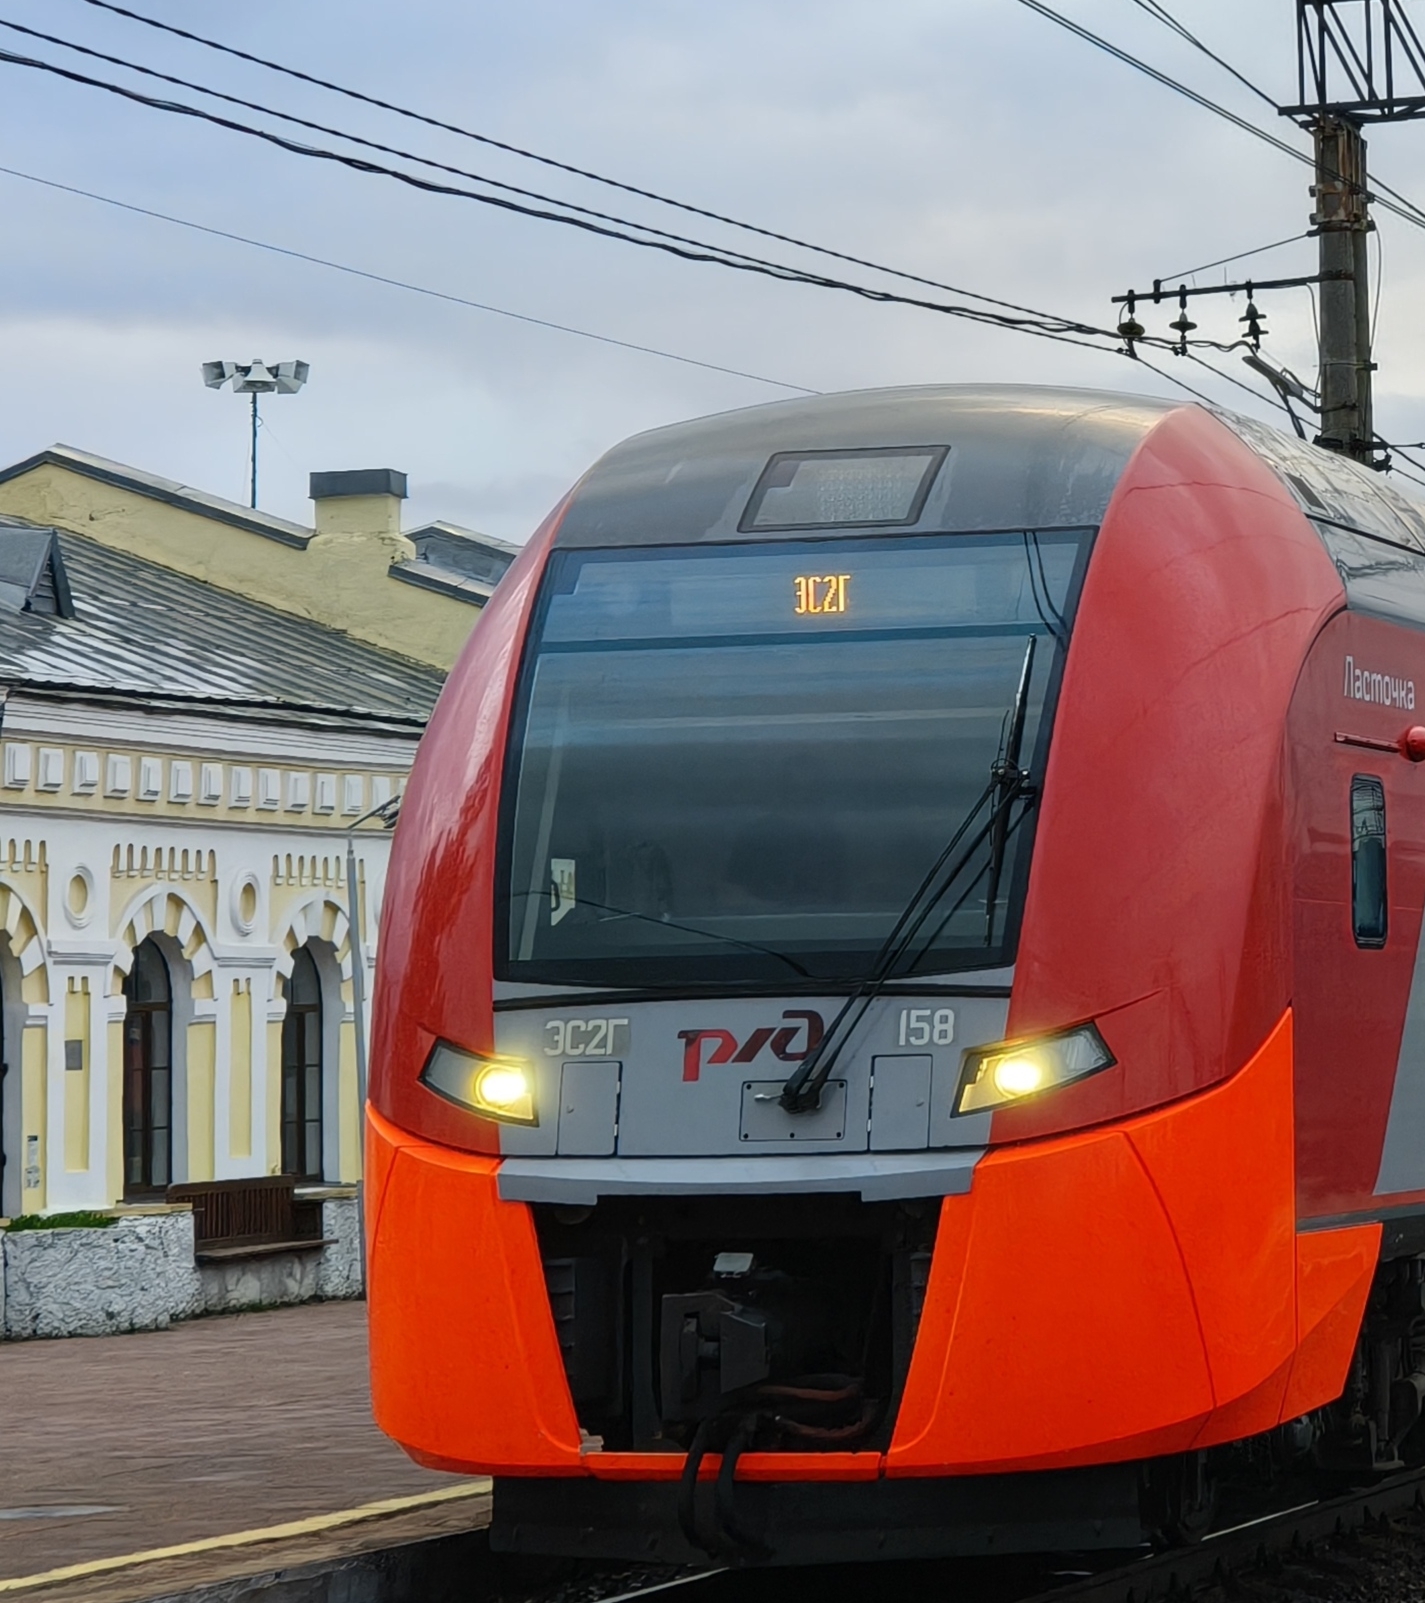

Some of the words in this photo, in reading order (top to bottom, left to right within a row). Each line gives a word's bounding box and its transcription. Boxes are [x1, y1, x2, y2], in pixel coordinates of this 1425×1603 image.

[794, 575, 850, 613] ЭС2Г
[1344, 655, 1415, 710] Ласточка
[544, 1018, 629, 1056] ЭС2Г
[899, 1008, 955, 1046] 158
